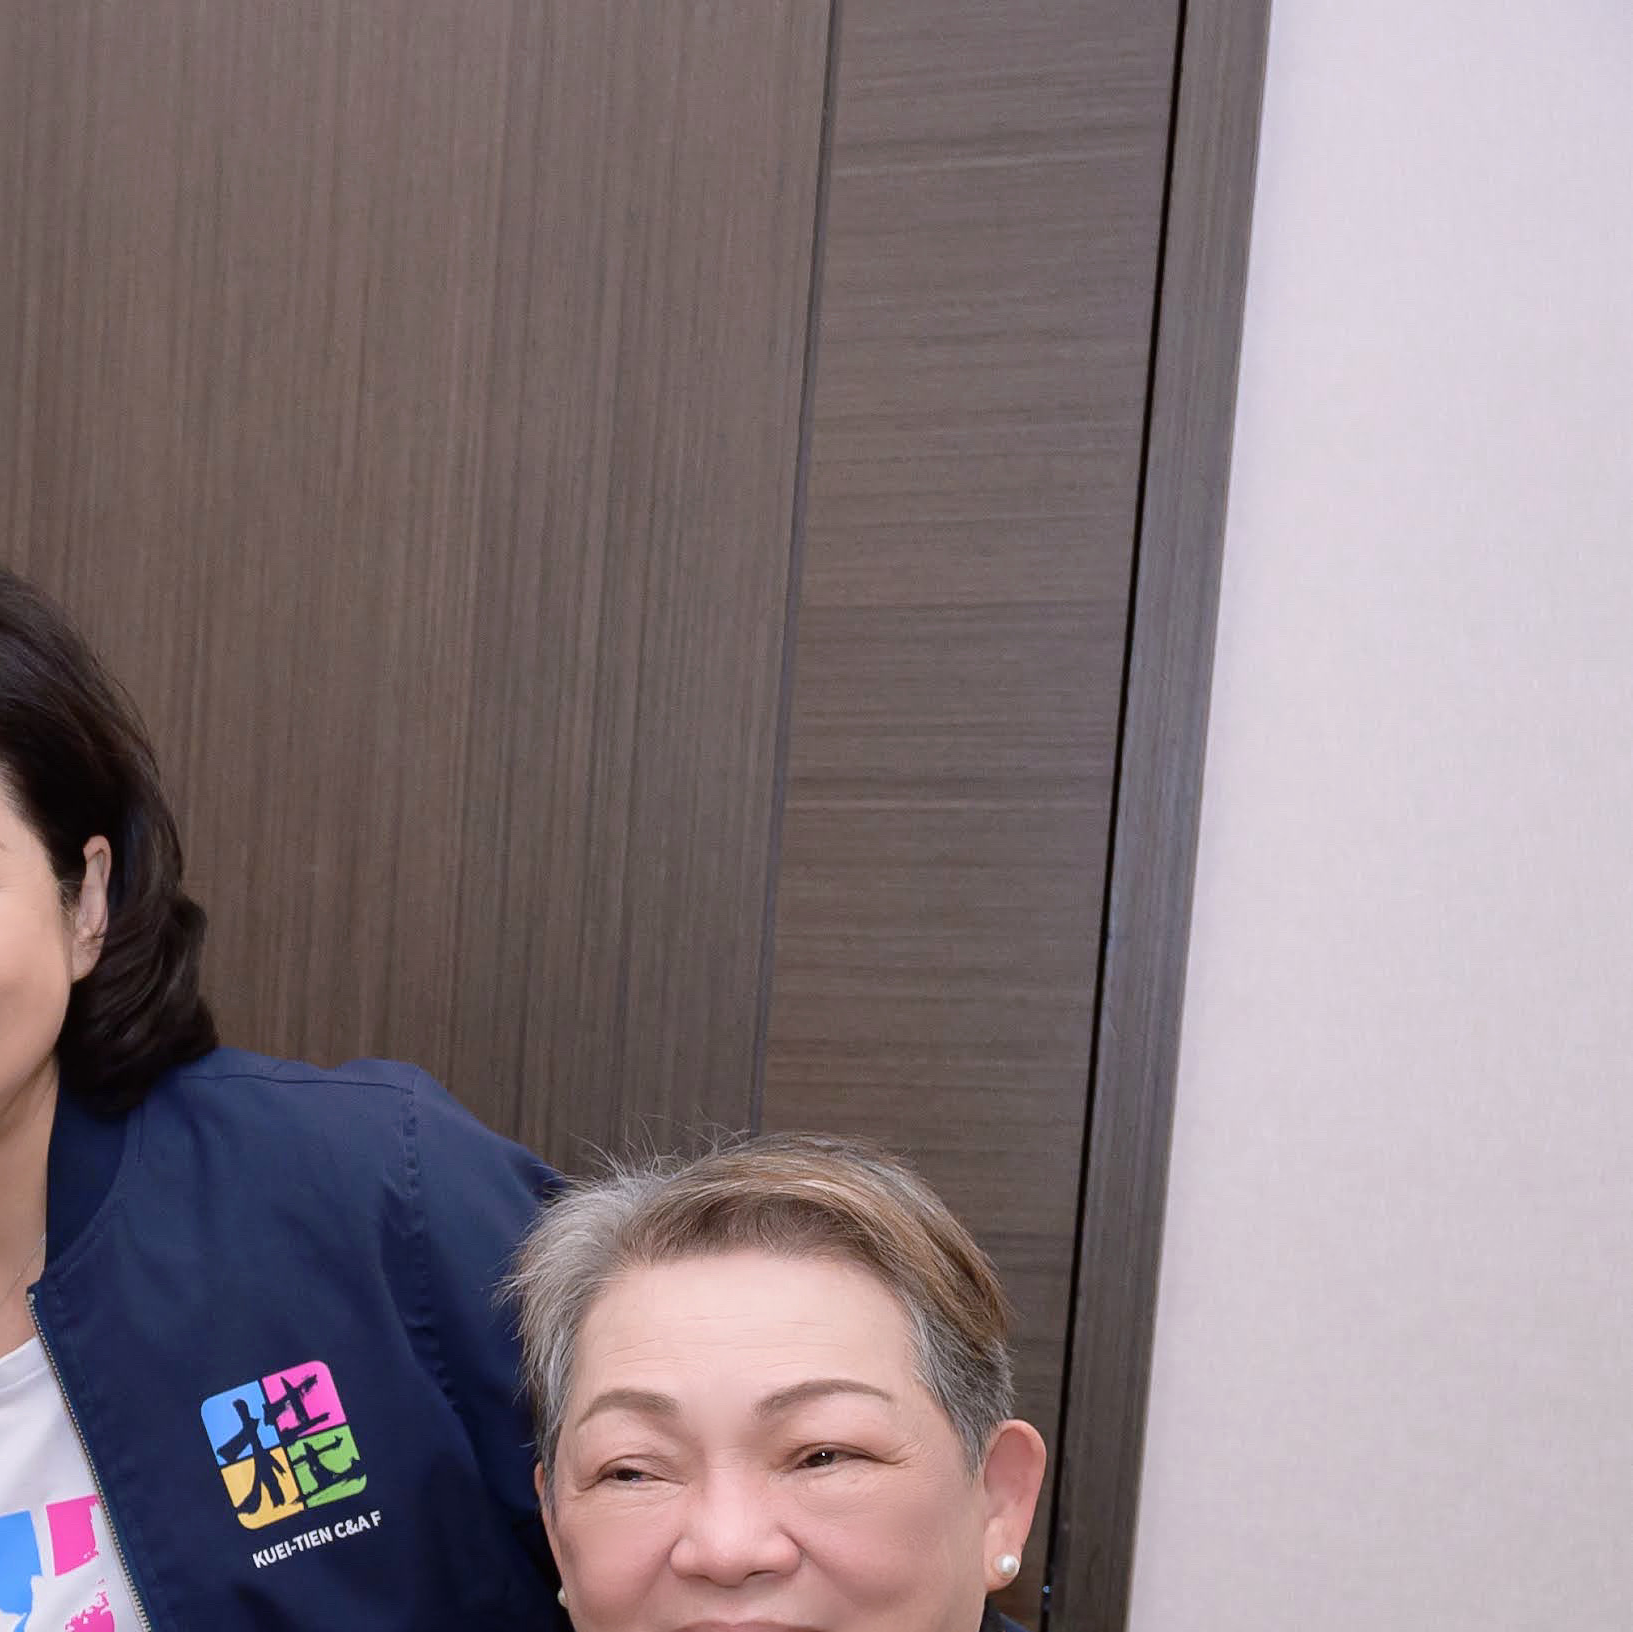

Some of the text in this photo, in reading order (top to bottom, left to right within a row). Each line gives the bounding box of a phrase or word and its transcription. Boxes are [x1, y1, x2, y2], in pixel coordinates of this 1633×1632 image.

[252, 1510, 382, 1568] KUEI-TIEN C&A F
